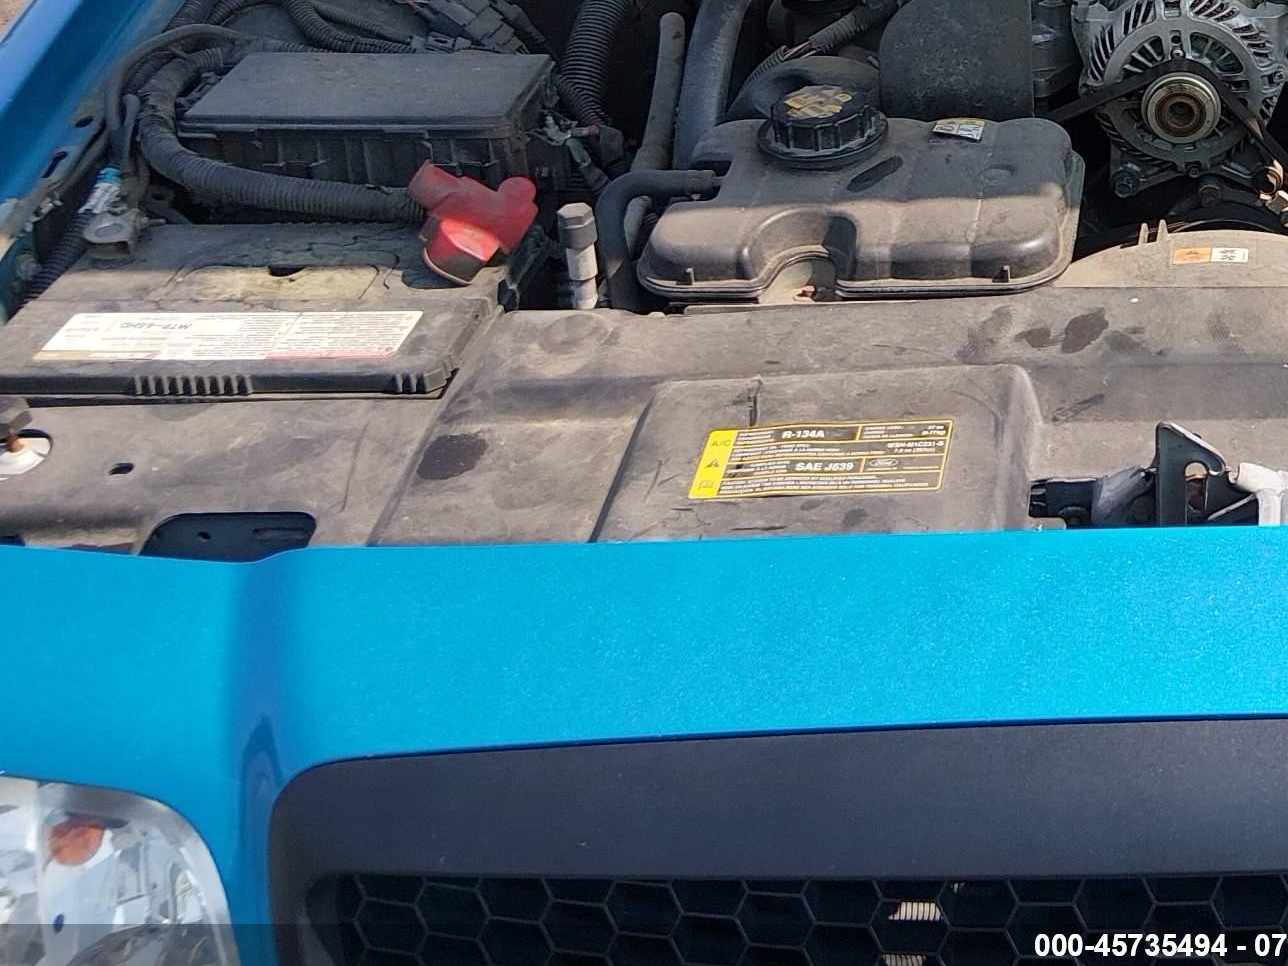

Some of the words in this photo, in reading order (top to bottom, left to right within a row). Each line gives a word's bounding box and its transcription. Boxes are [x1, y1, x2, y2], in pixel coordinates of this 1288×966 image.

[782, 430, 825, 439] R-134A
[795, 462, 823, 471] SAE
[824, 462, 854, 471] J639
